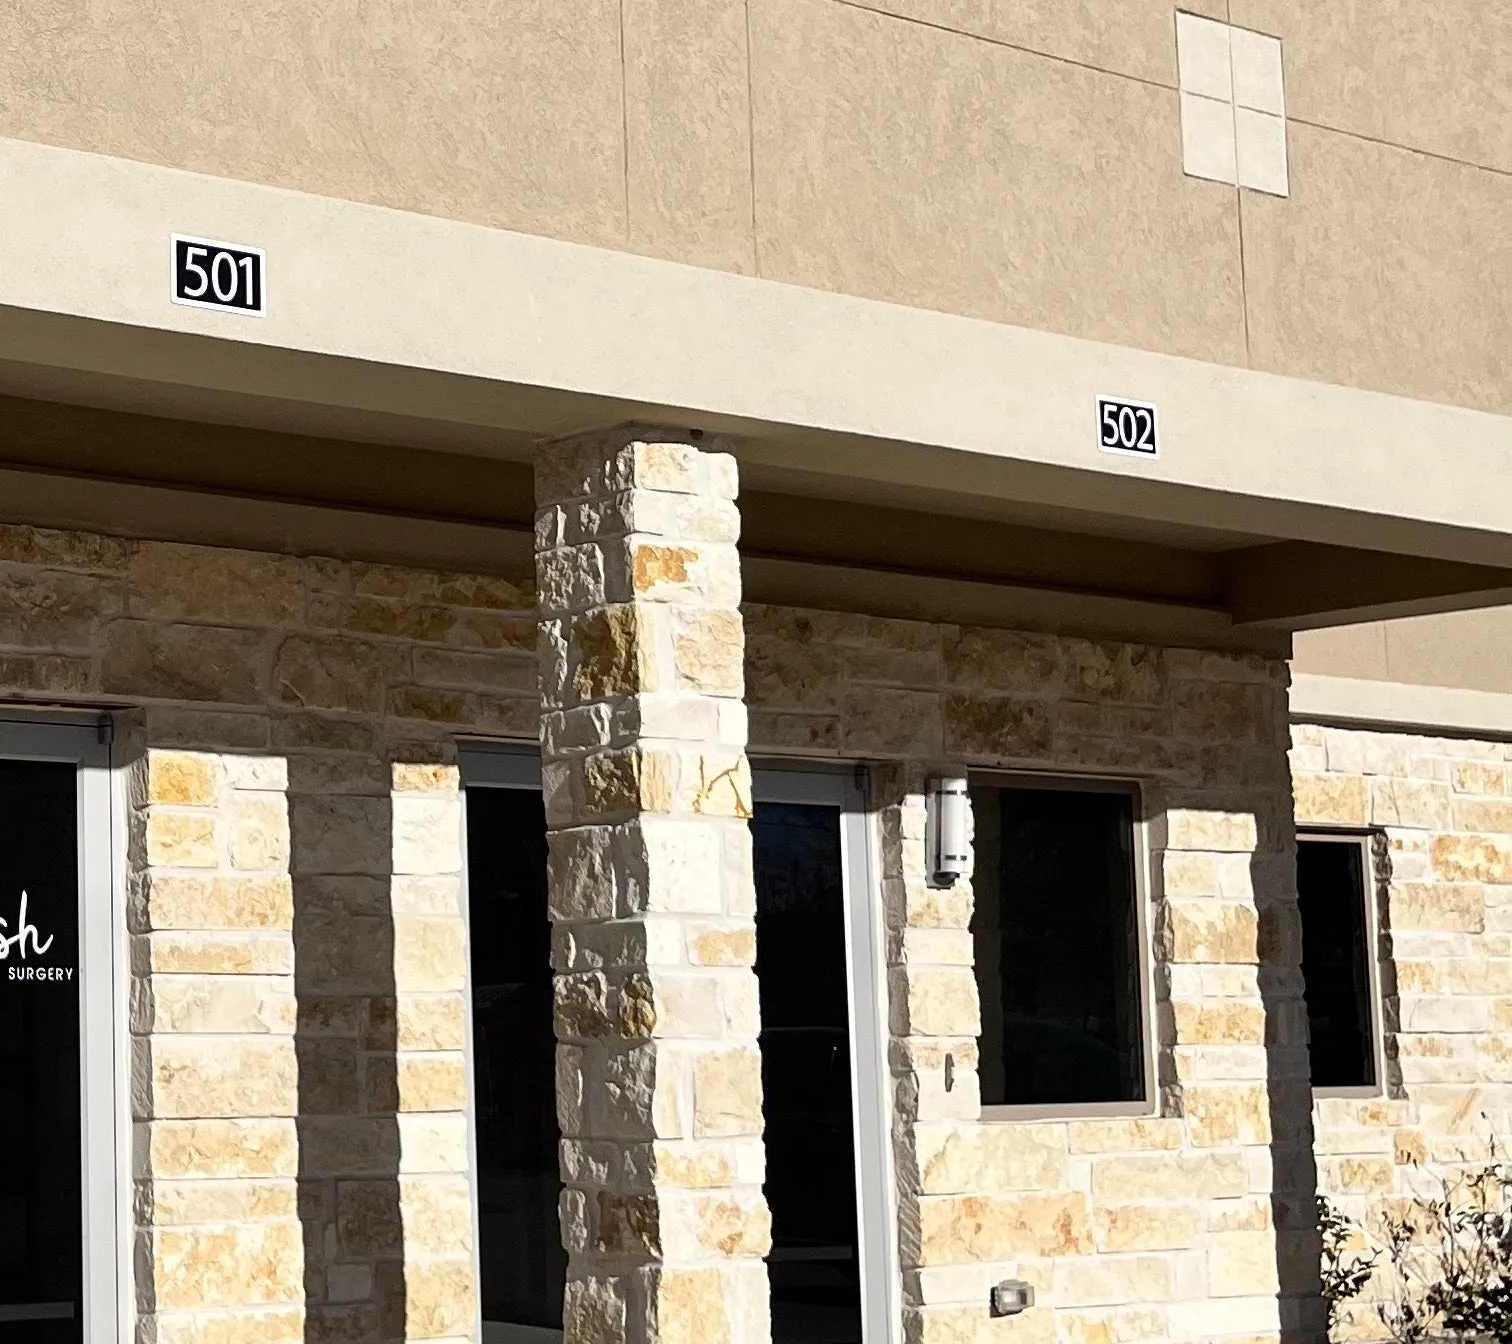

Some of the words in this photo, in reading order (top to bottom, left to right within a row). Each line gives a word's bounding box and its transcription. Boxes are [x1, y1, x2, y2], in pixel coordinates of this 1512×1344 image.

[183, 246, 254, 306] 501
[1103, 403, 1154, 451] 502
[8, 966, 74, 981] SURGERY
